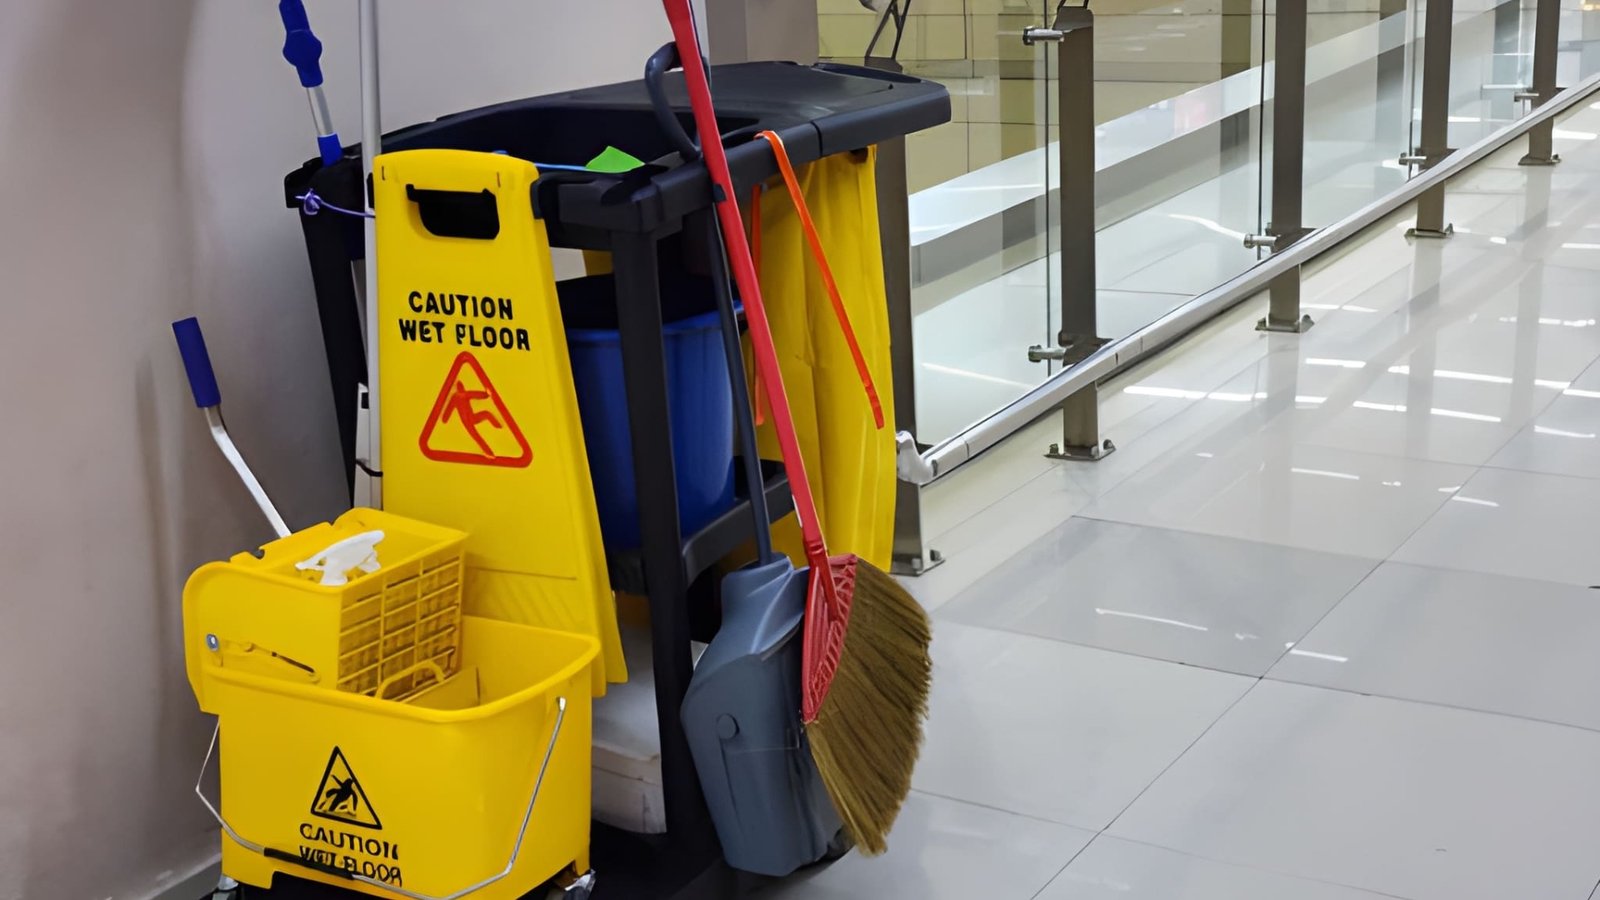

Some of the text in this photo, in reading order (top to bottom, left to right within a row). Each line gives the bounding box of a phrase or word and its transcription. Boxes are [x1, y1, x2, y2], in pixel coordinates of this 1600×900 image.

[408, 291, 513, 320] CAUTION
[398, 318, 530, 351] WET FLOOR
[299, 823, 399, 860] CAUTION
